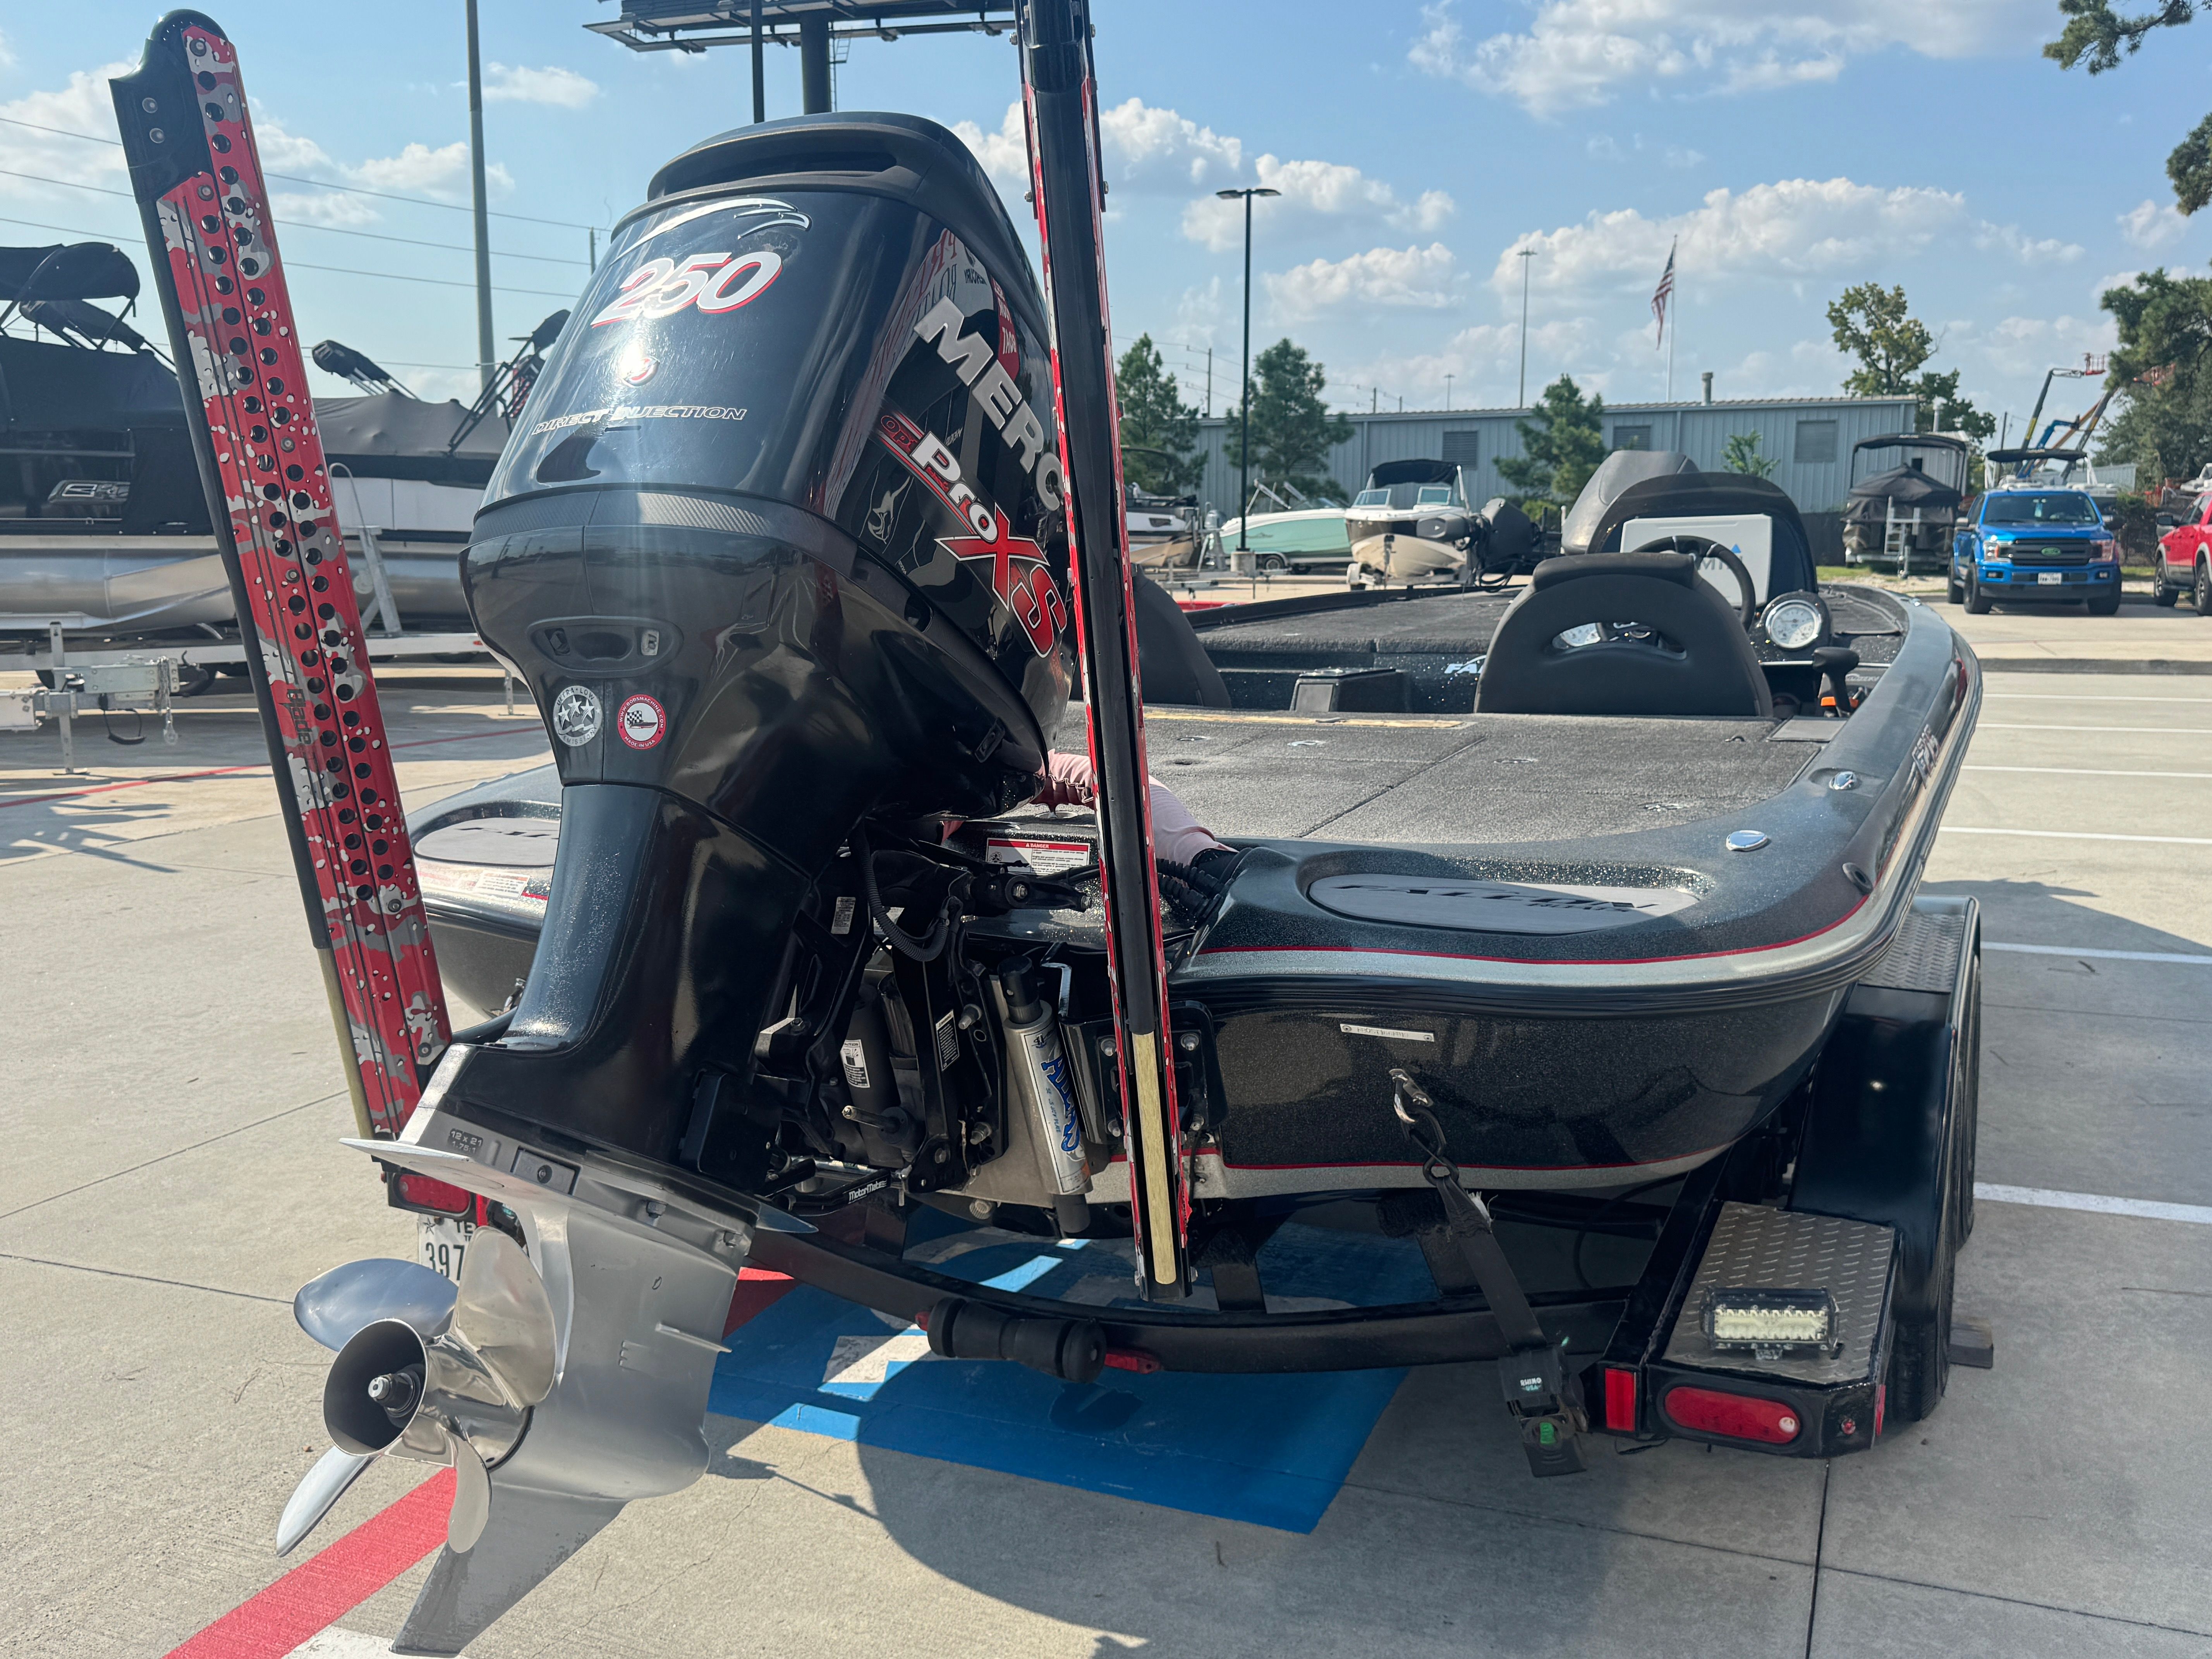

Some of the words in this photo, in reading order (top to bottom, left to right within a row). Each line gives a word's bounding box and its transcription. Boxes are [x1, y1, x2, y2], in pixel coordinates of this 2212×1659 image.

[591, 251, 783, 328] 250
[913, 295, 1064, 512] MERC
[532, 408, 610, 435] DIRECT
[608, 405, 747, 421] INJECTION
[557, 687, 575, 706] ULTRA
[580, 688, 595, 700] LOW
[624, 736, 637, 747] MADE
[451, 1131, 462, 1140] 12
[470, 1137, 482, 1147] 21
[426, 1242, 465, 1281] 397
[1520, 1377, 1542, 1386] RHINO
